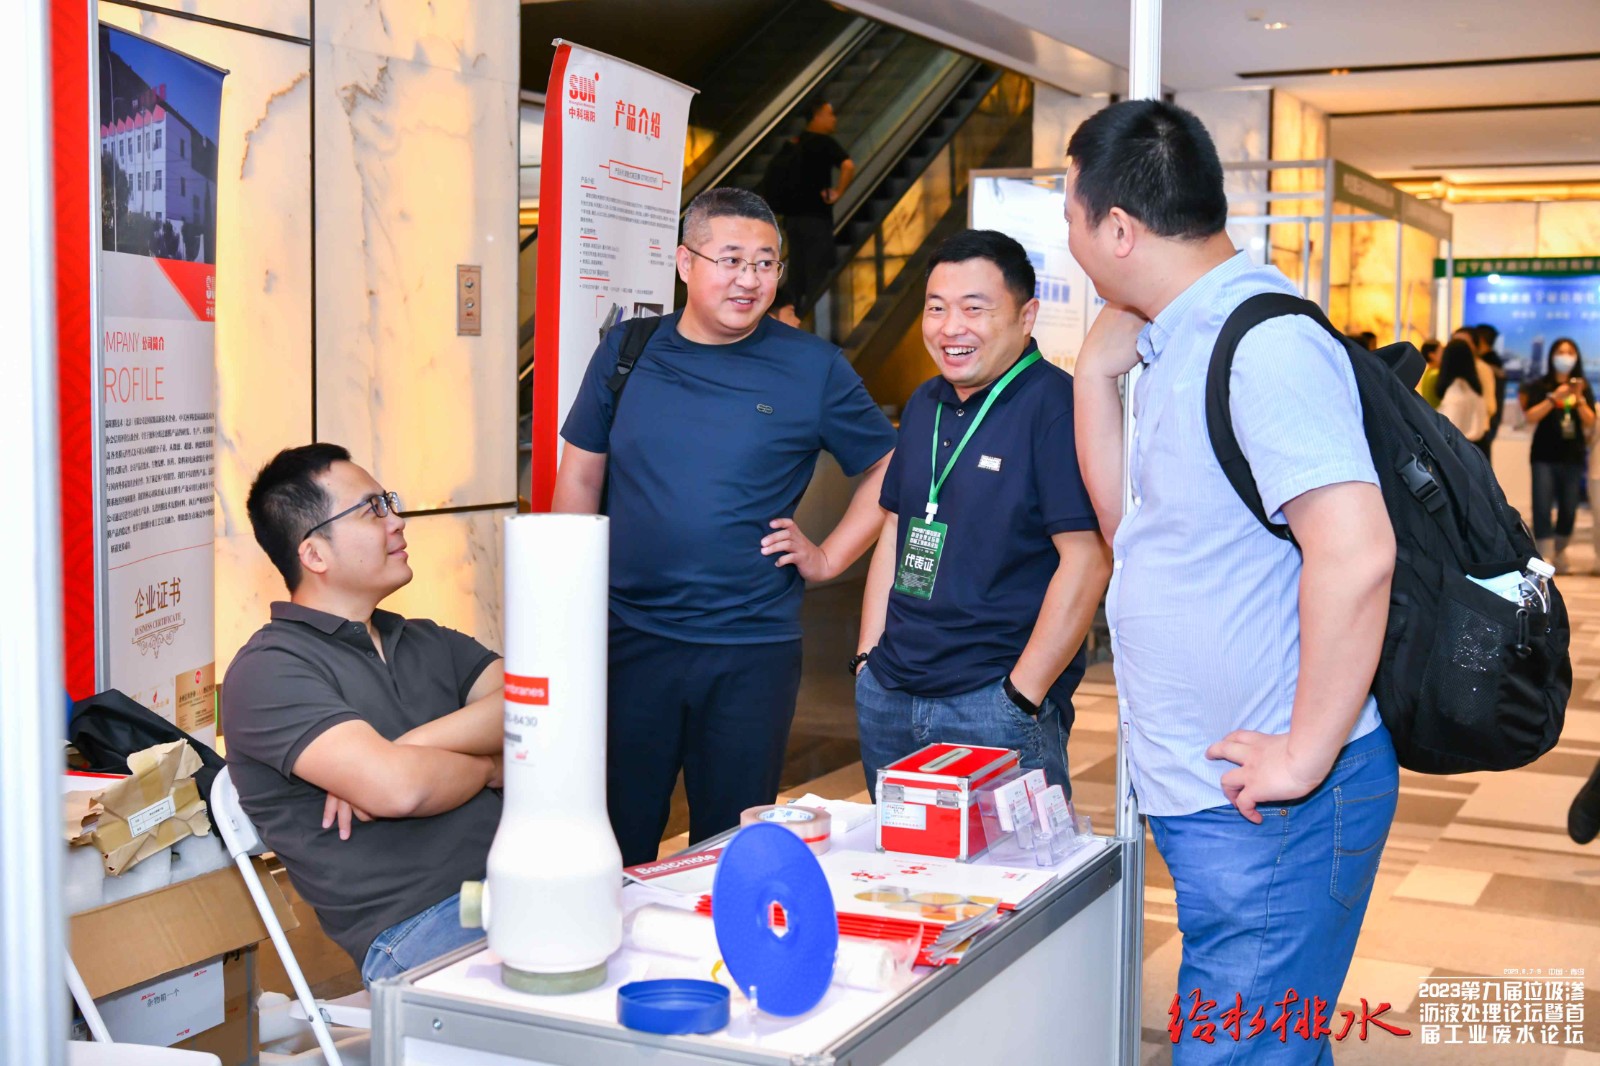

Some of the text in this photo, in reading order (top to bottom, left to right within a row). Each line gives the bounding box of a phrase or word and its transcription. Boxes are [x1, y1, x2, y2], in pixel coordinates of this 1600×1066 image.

[569, 73, 596, 104] SUN
[568, 106, 596, 123] 中科瑞阳
[615, 99, 661, 139] 产品介绍
[103, 331, 165, 353] MPANY 公司简介
[904, 552, 935, 573] 代表证
[134, 577, 182, 619] 企业证书
